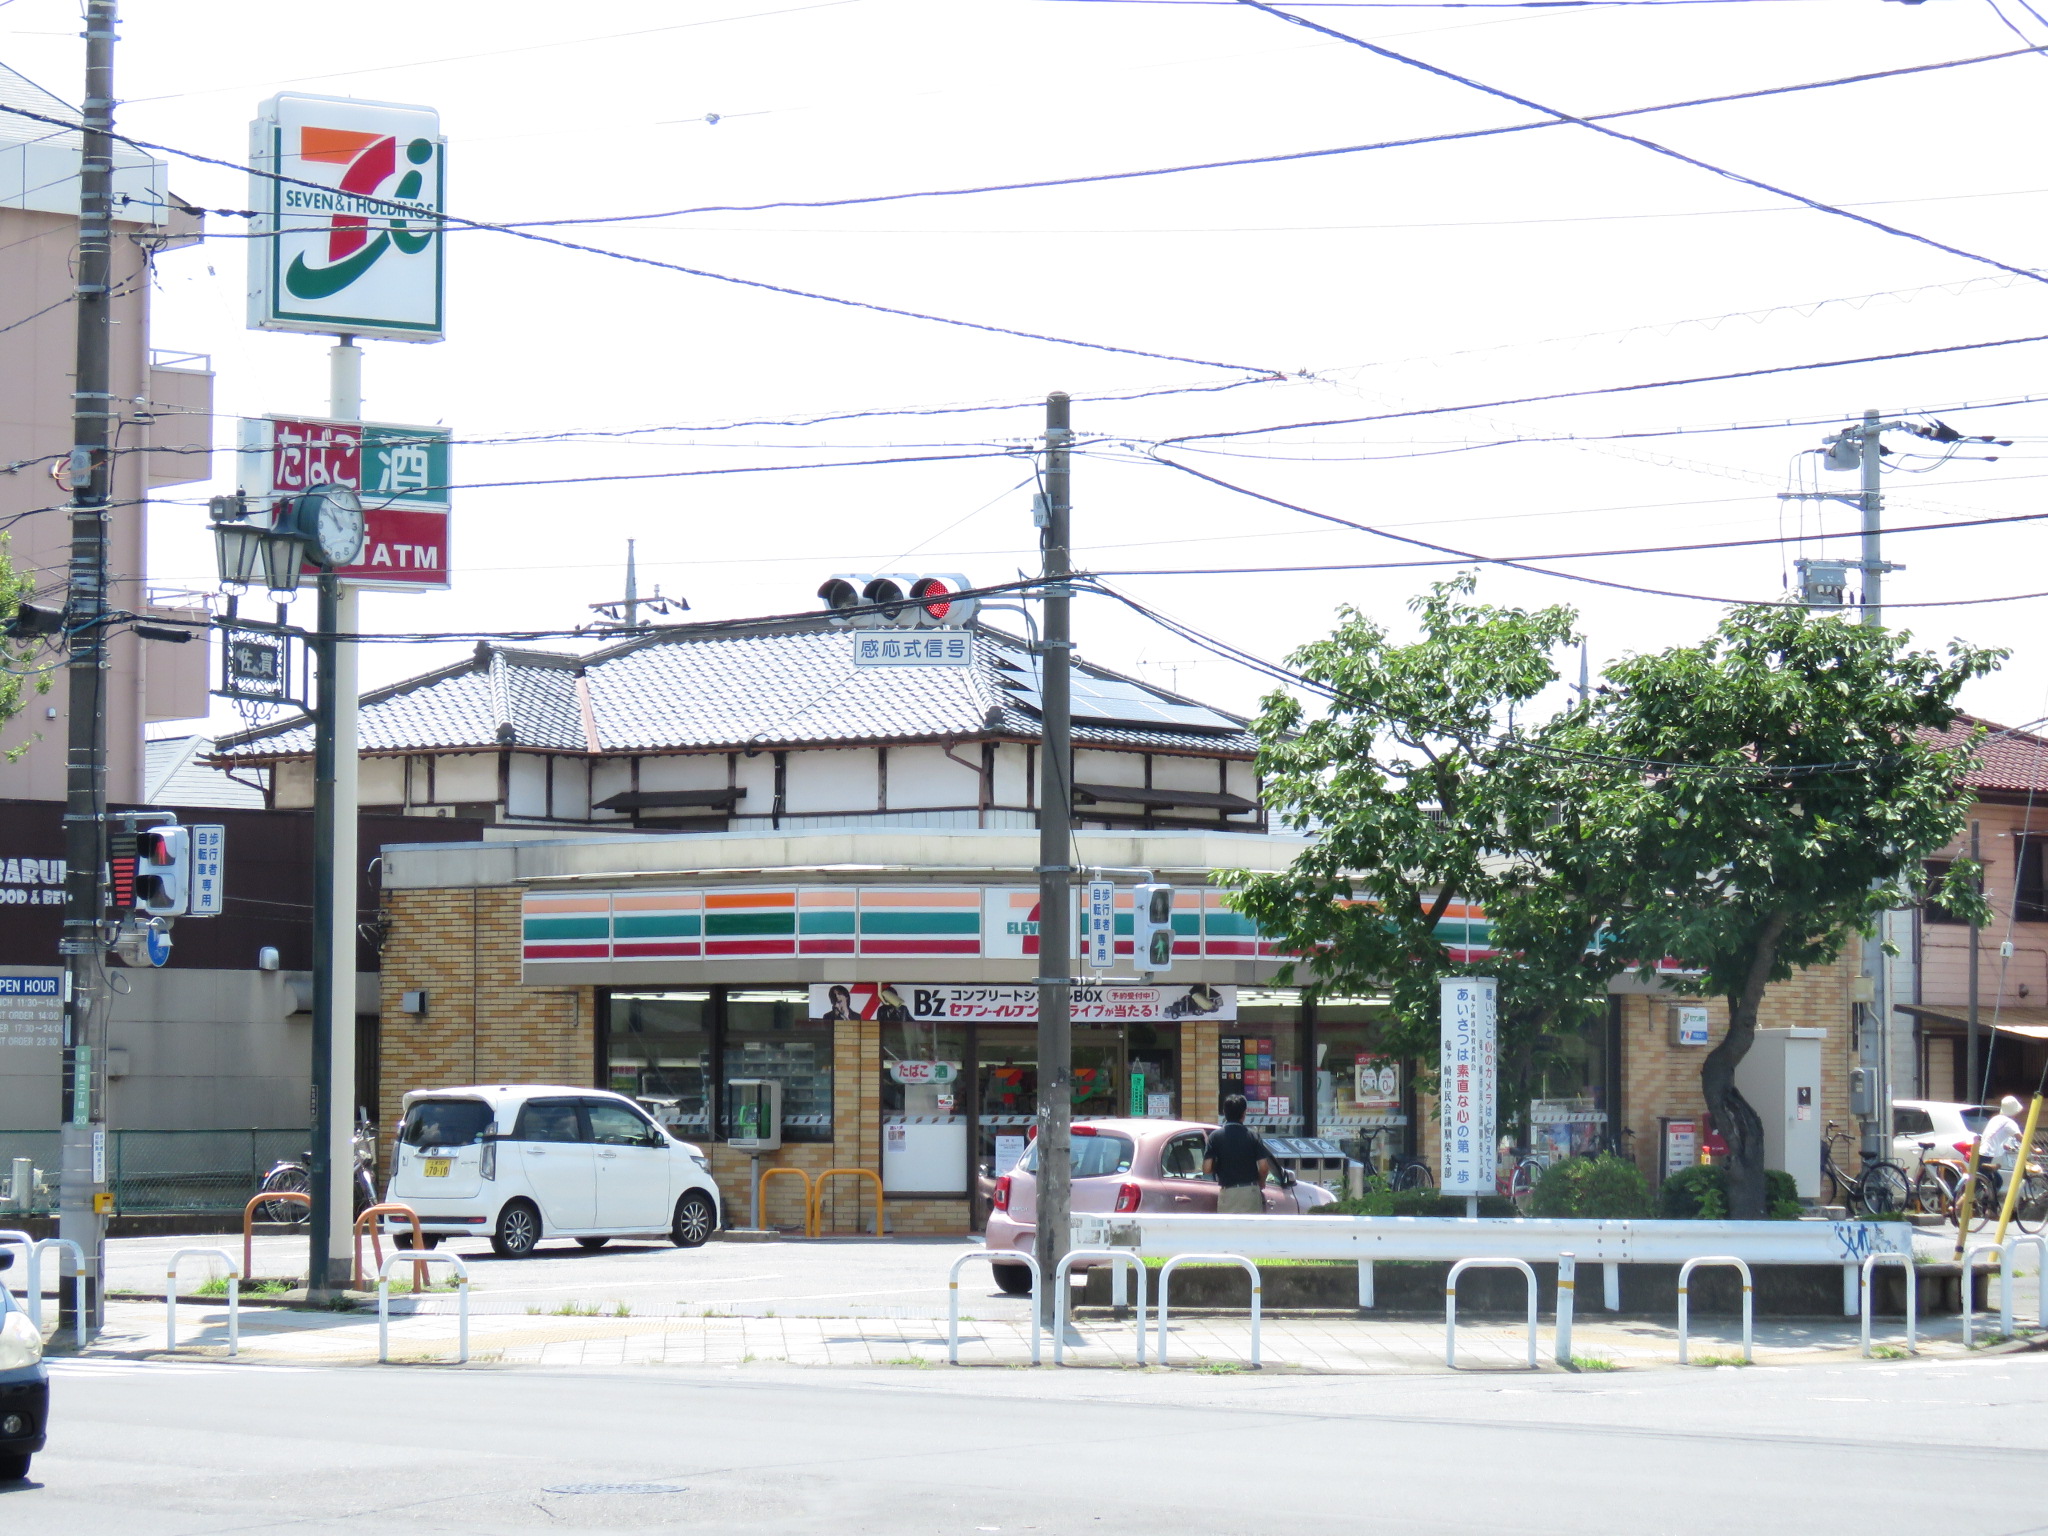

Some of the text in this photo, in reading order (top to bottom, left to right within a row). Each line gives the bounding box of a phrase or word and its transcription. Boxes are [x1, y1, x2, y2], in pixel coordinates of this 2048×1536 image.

[276, 426, 356, 488] たばこ
[378, 434, 428, 495] 酒
[371, 544, 438, 570] ATM
[860, 638, 966, 659] 感応式信号
[197, 833, 207, 875] 自転車
[209, 833, 219, 876] 歩行者
[201, 879, 212, 907] 専用
[1093, 889, 1102, 931] 自転車
[1102, 889, 1110, 931] 歩行者
[1006, 921, 1040, 935] ELEV
[1097, 934, 1106, 961] 専用
[24, 979, 56, 993] HOUR
[8, 1011, 34, 1020] ORDER
[38, 1011, 59, 1020] 14:00
[8, 1037, 34, 1047] ORDER
[899, 1064, 929, 1077] たばこ
[935, 1065, 948, 1078] 酒
[1457, 988, 1469, 1184] あいさつは素直な心の第一歩
[75, 1115, 87, 1125] 20
